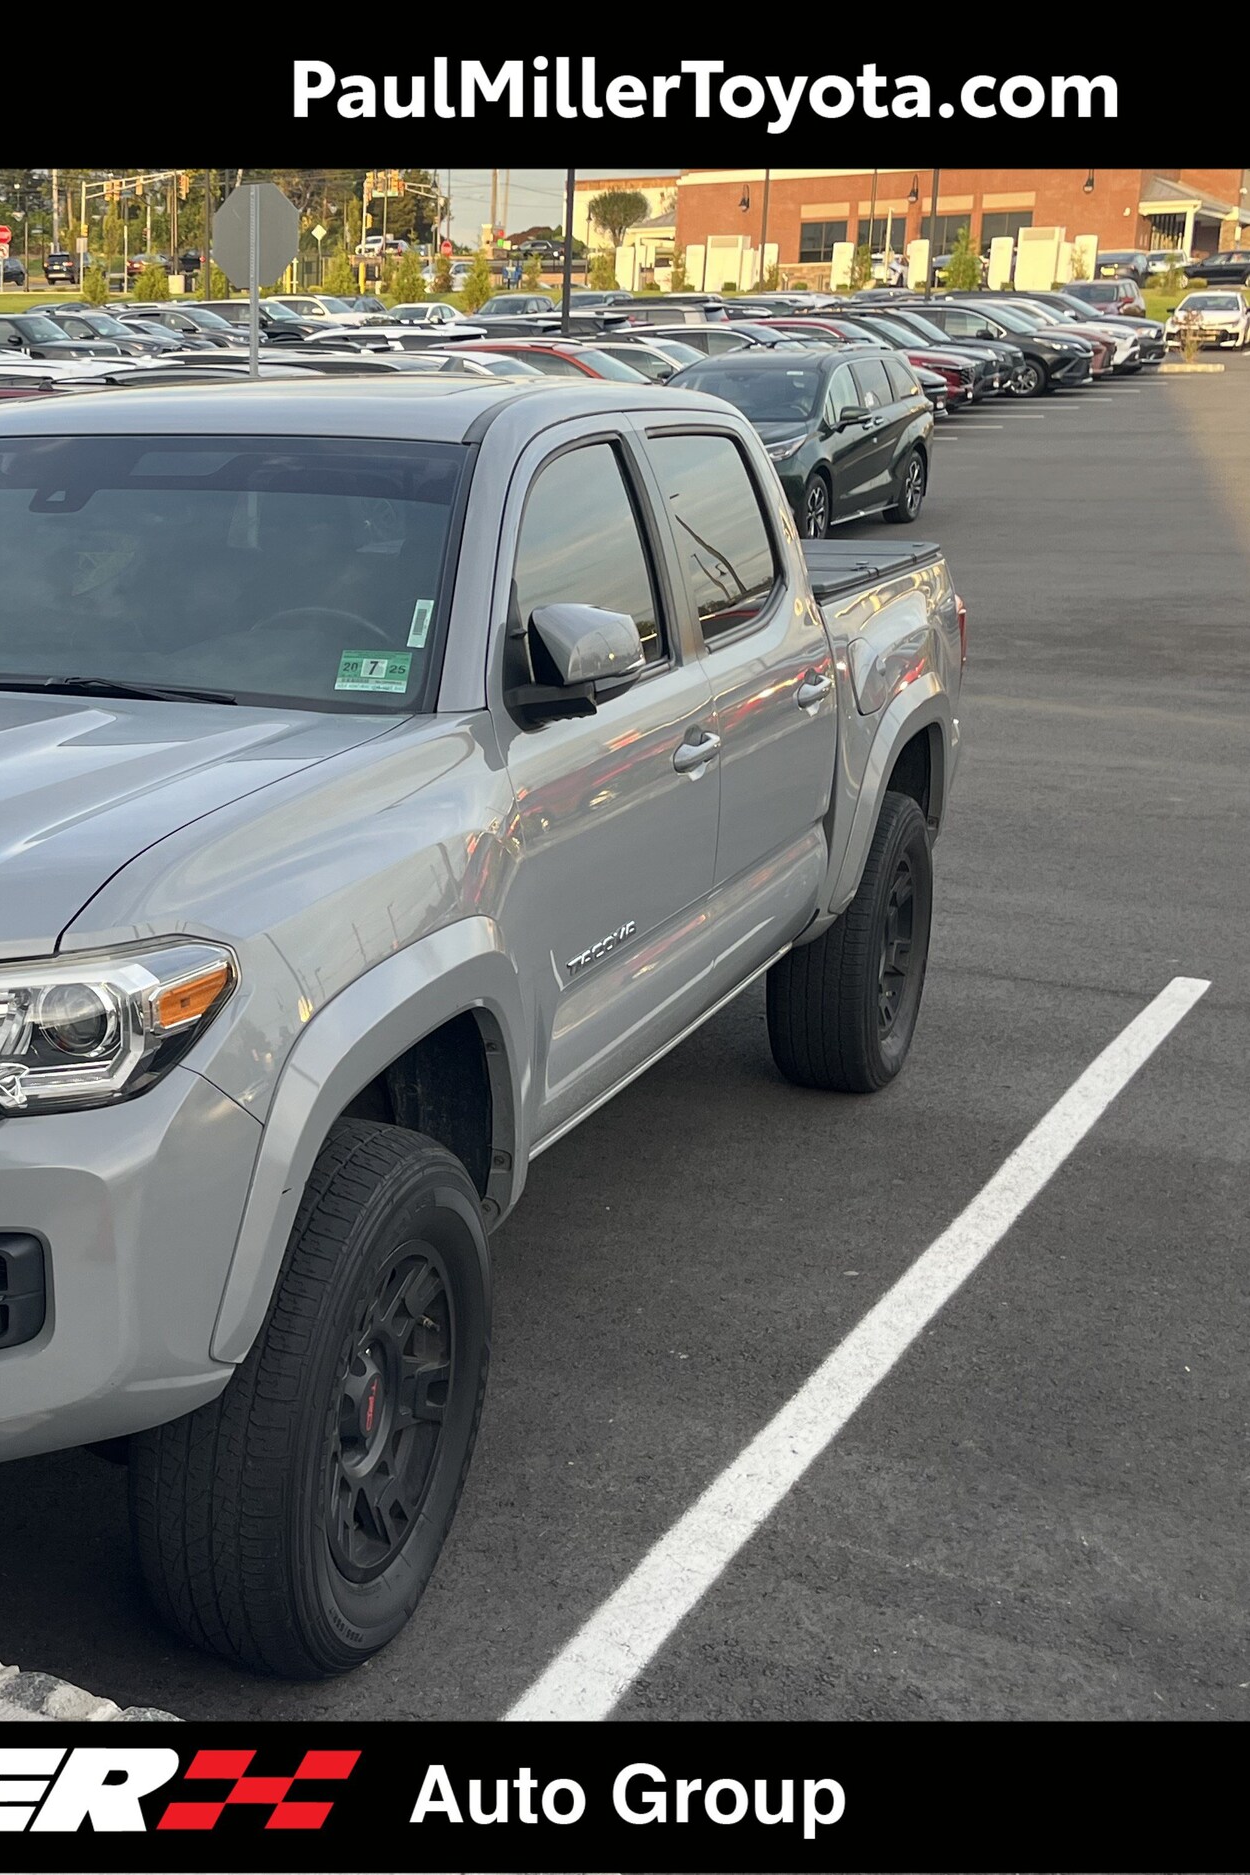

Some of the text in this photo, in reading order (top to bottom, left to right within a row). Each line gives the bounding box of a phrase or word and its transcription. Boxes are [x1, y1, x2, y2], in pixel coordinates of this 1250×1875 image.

[343, 660, 406, 676] 20 7 25
